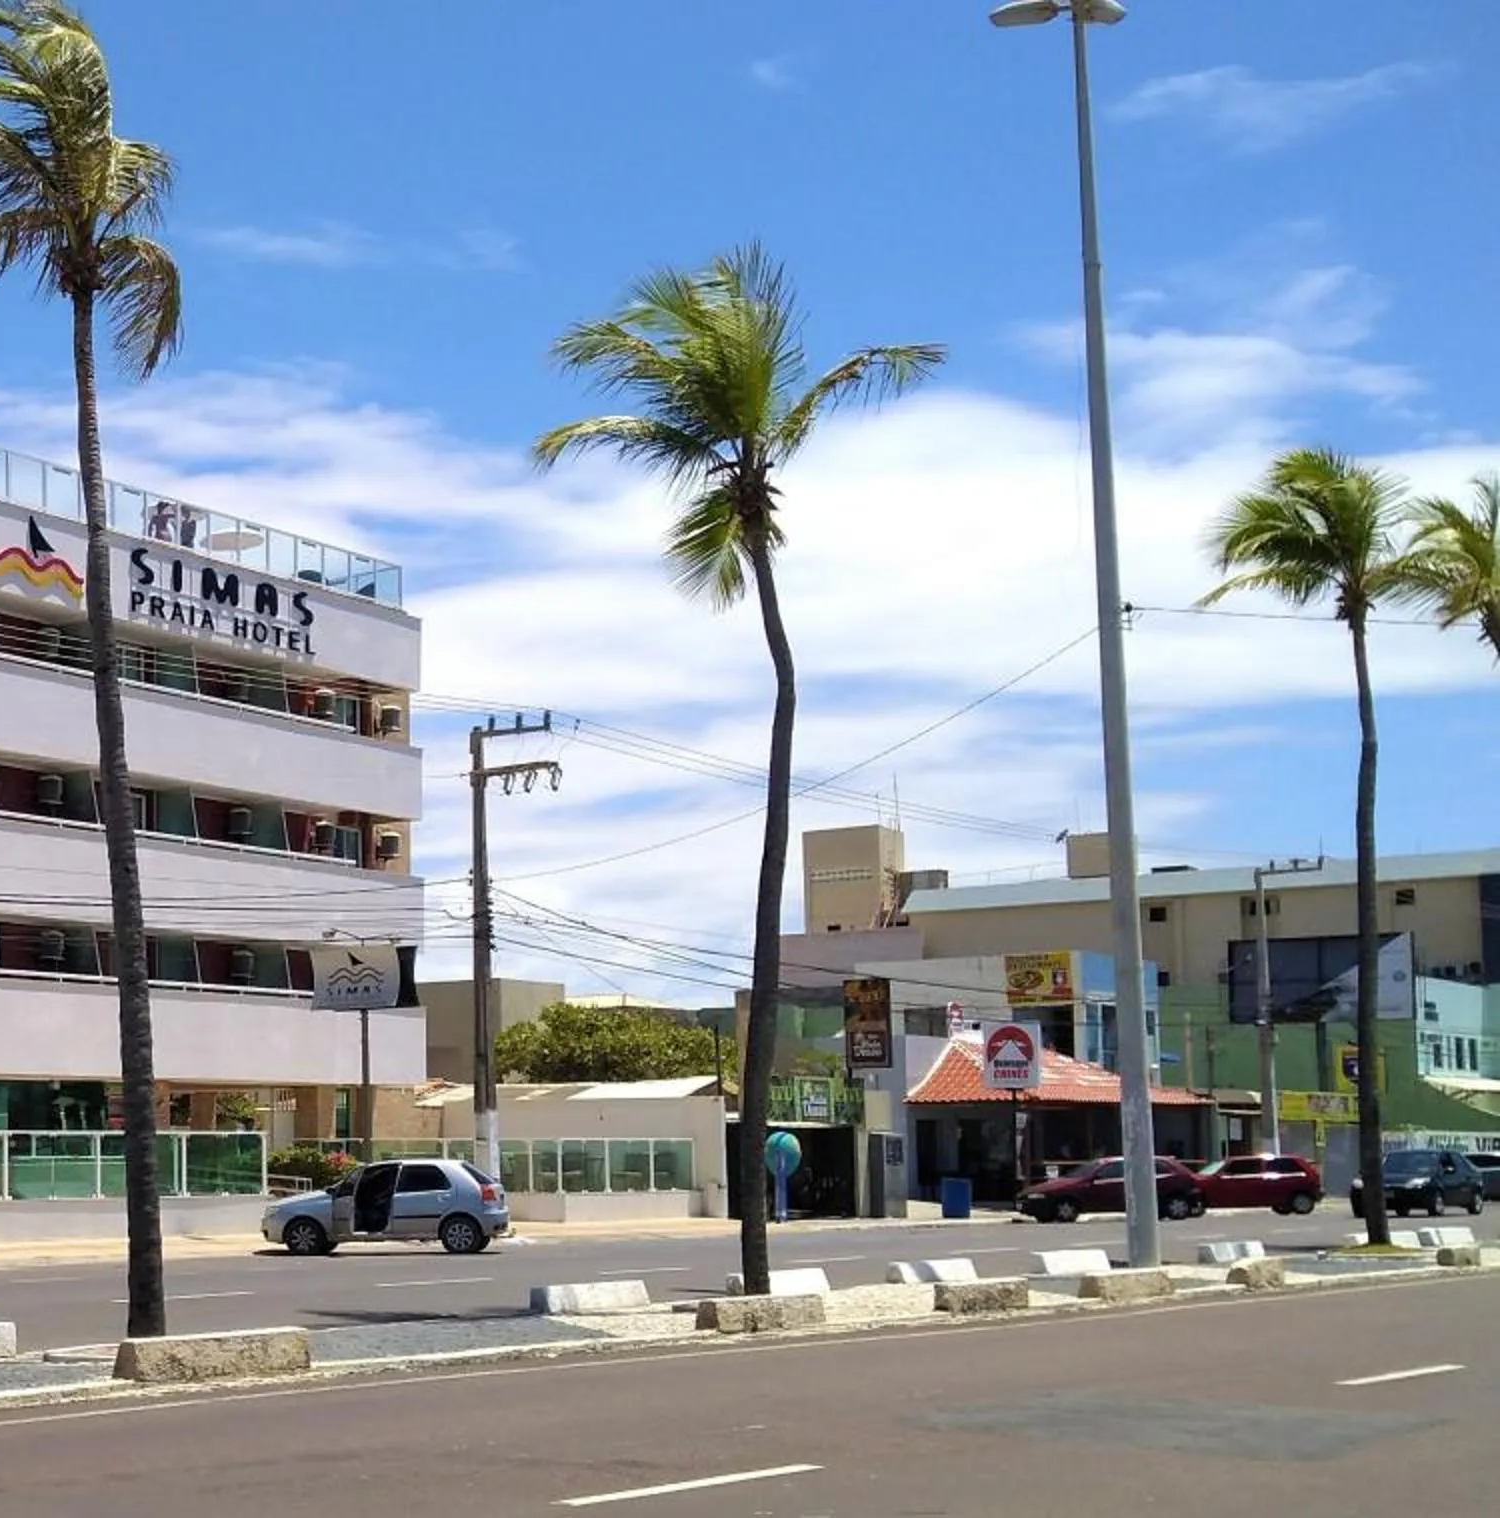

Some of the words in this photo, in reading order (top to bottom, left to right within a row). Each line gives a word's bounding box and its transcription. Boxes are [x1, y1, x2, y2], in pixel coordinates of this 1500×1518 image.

[131, 548, 314, 627] SIMAS
[131, 591, 215, 631] PRAIA
[233, 617, 316, 655] HOTEL
